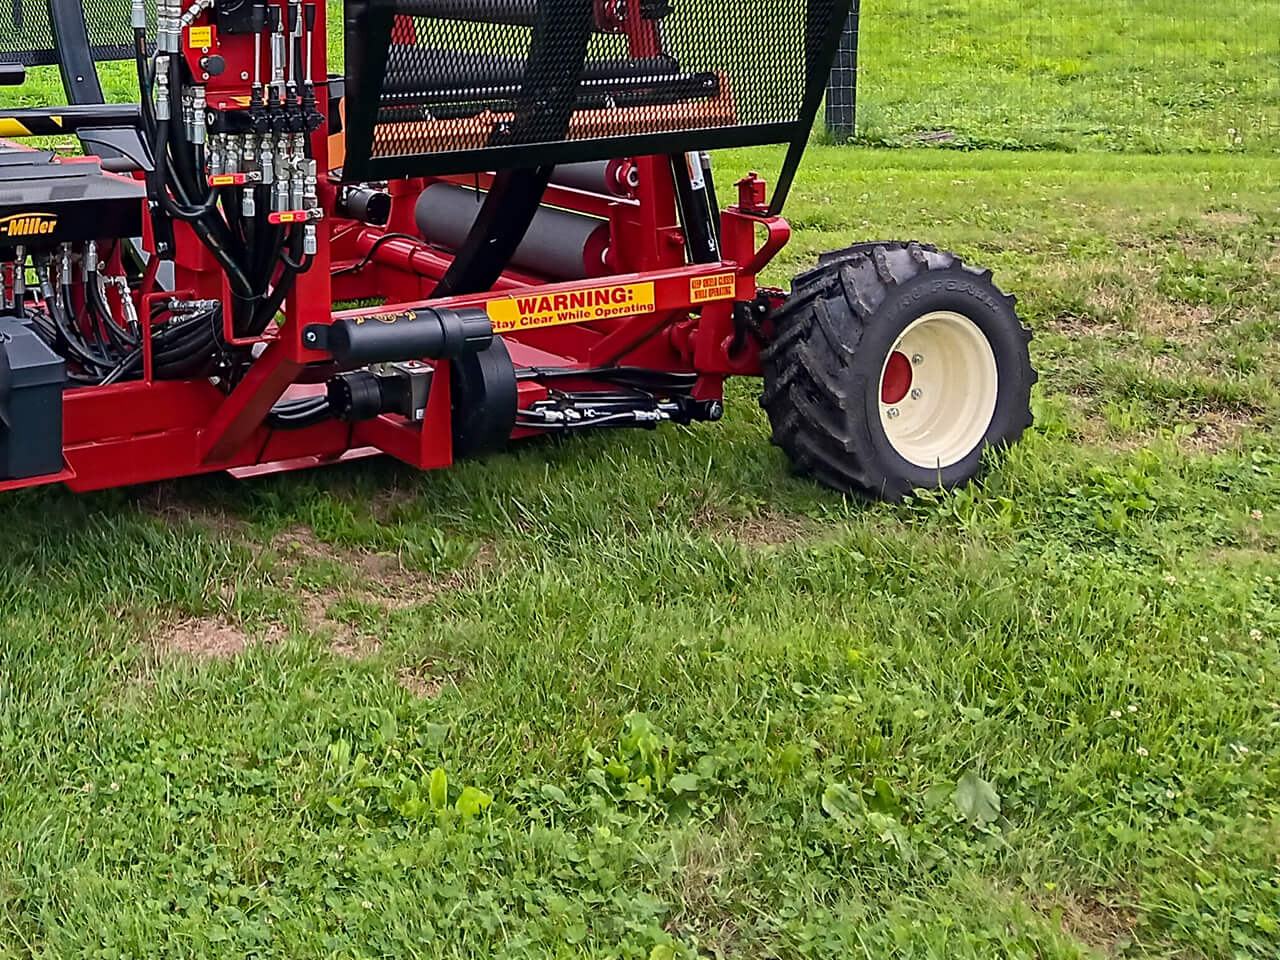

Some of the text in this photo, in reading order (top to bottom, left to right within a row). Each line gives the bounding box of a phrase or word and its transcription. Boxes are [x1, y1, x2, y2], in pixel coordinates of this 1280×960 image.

[517, 287, 633, 315] WARNING:
[491, 302, 654, 330] Stay Clear While Operating
